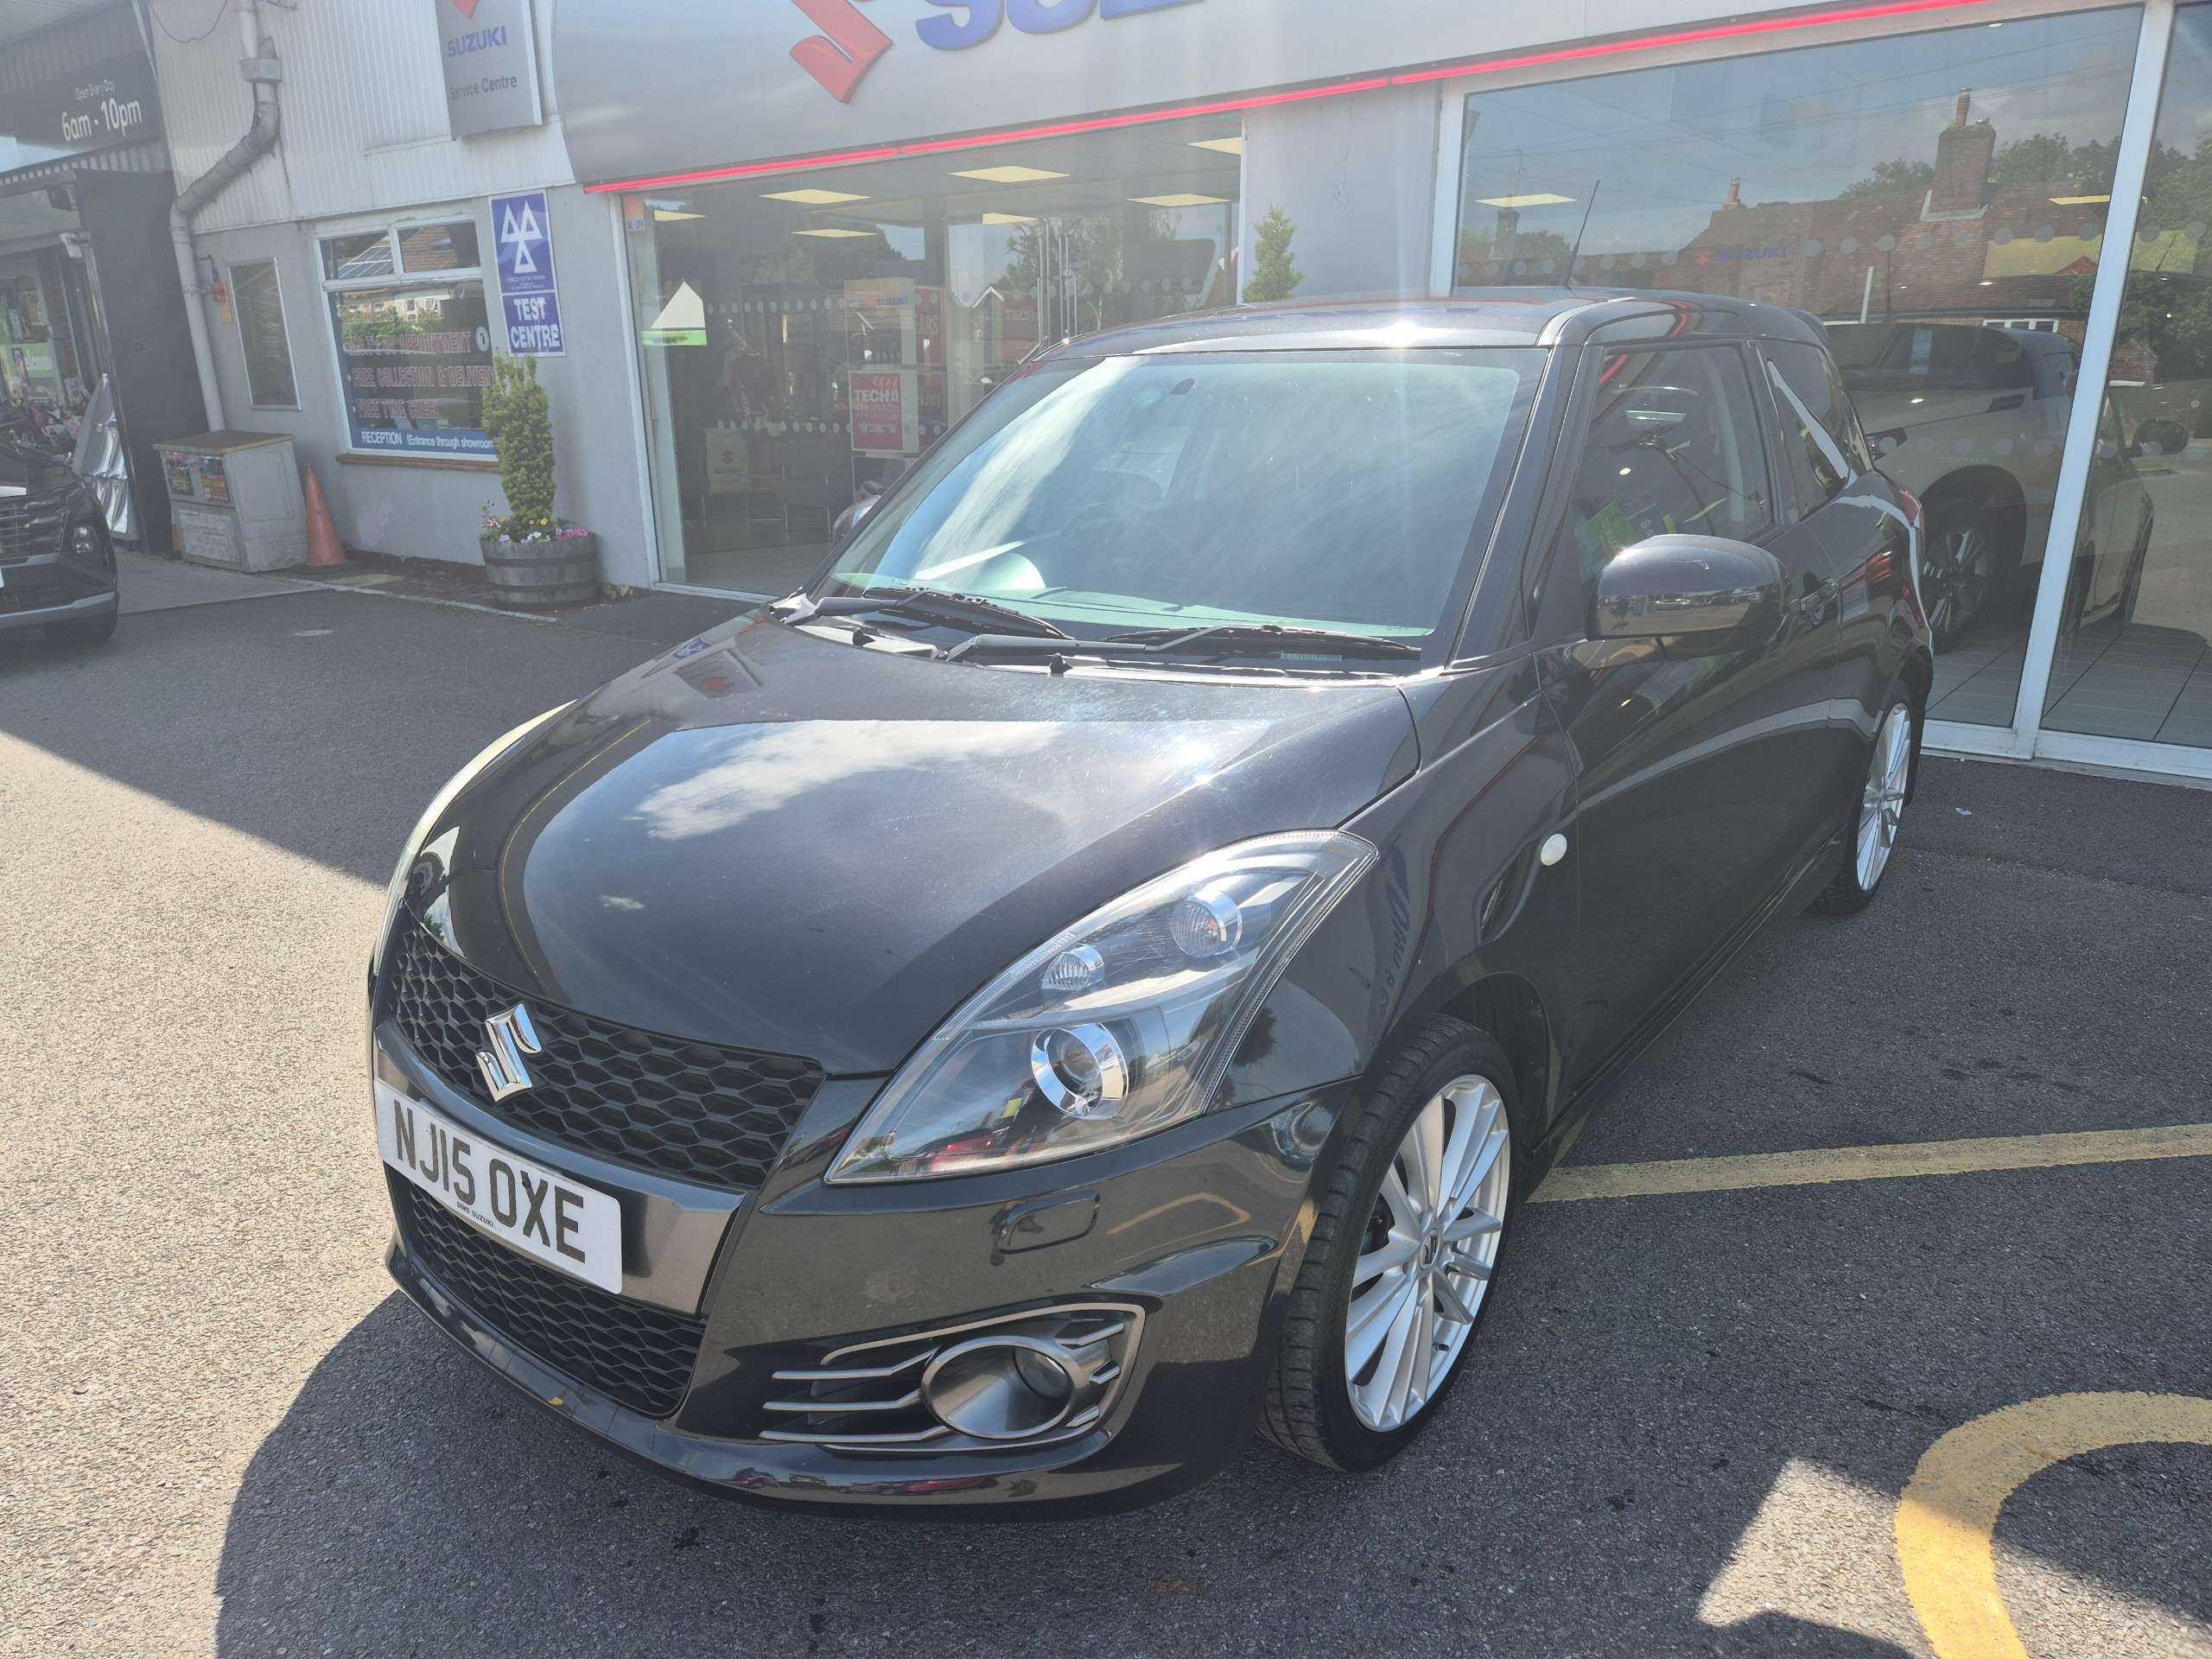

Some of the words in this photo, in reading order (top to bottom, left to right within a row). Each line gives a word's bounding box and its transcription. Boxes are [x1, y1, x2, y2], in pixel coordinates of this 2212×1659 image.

[448, 26, 508, 57] SUZUKI
[449, 83, 480, 101] Service
[482, 76, 518, 93] Centre
[61, 111, 92, 142] 6am
[100, 98, 143, 137] 10pm
[513, 296, 547, 321] TEST
[511, 324, 561, 349] CENTRE
[377, 366, 435, 387] COLLECTION
[854, 389, 889, 402] TECH
[361, 431, 403, 445] RECEPTION
[436, 435, 461, 449] through
[394, 1099, 475, 1205] NJ15
[489, 1158, 586, 1263] OXE
[472, 1210, 494, 1228] SUZUKI
